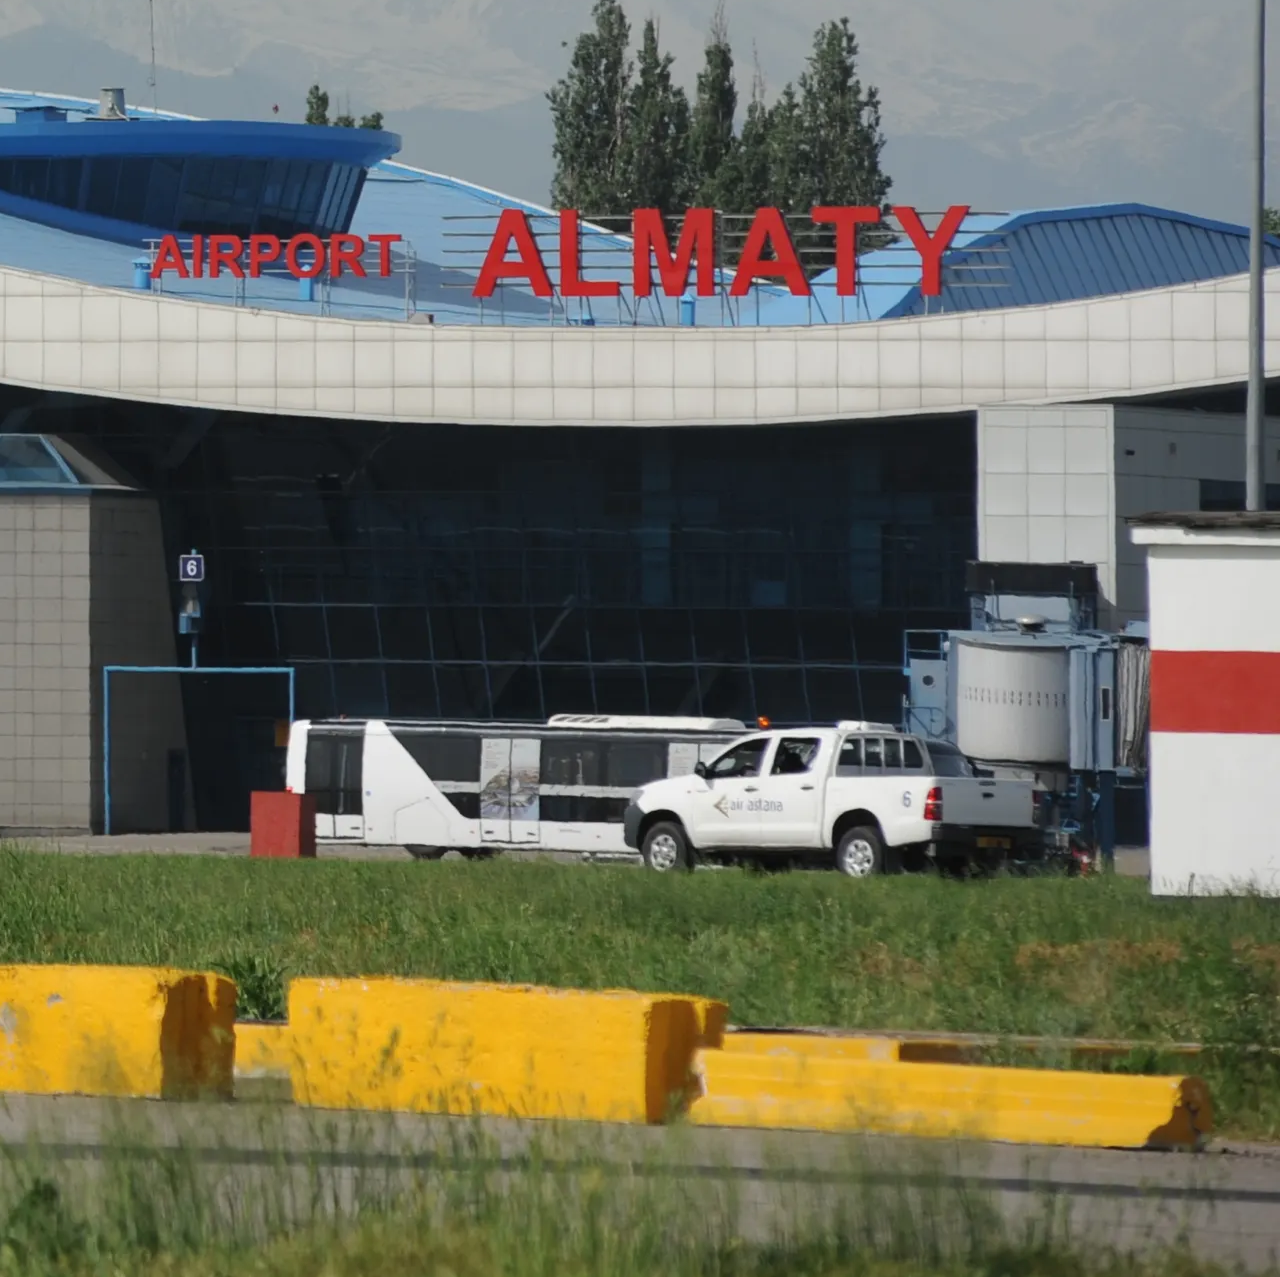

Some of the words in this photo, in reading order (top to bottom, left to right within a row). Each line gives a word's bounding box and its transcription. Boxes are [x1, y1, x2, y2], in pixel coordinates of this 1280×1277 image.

[150, 233, 403, 279] AIRPORT
[472, 205, 971, 297] ALMATY
[186, 559, 197, 576] 6
[731, 798, 743, 811] air
[747, 798, 783, 812] astana
[902, 791, 912, 808] 6
